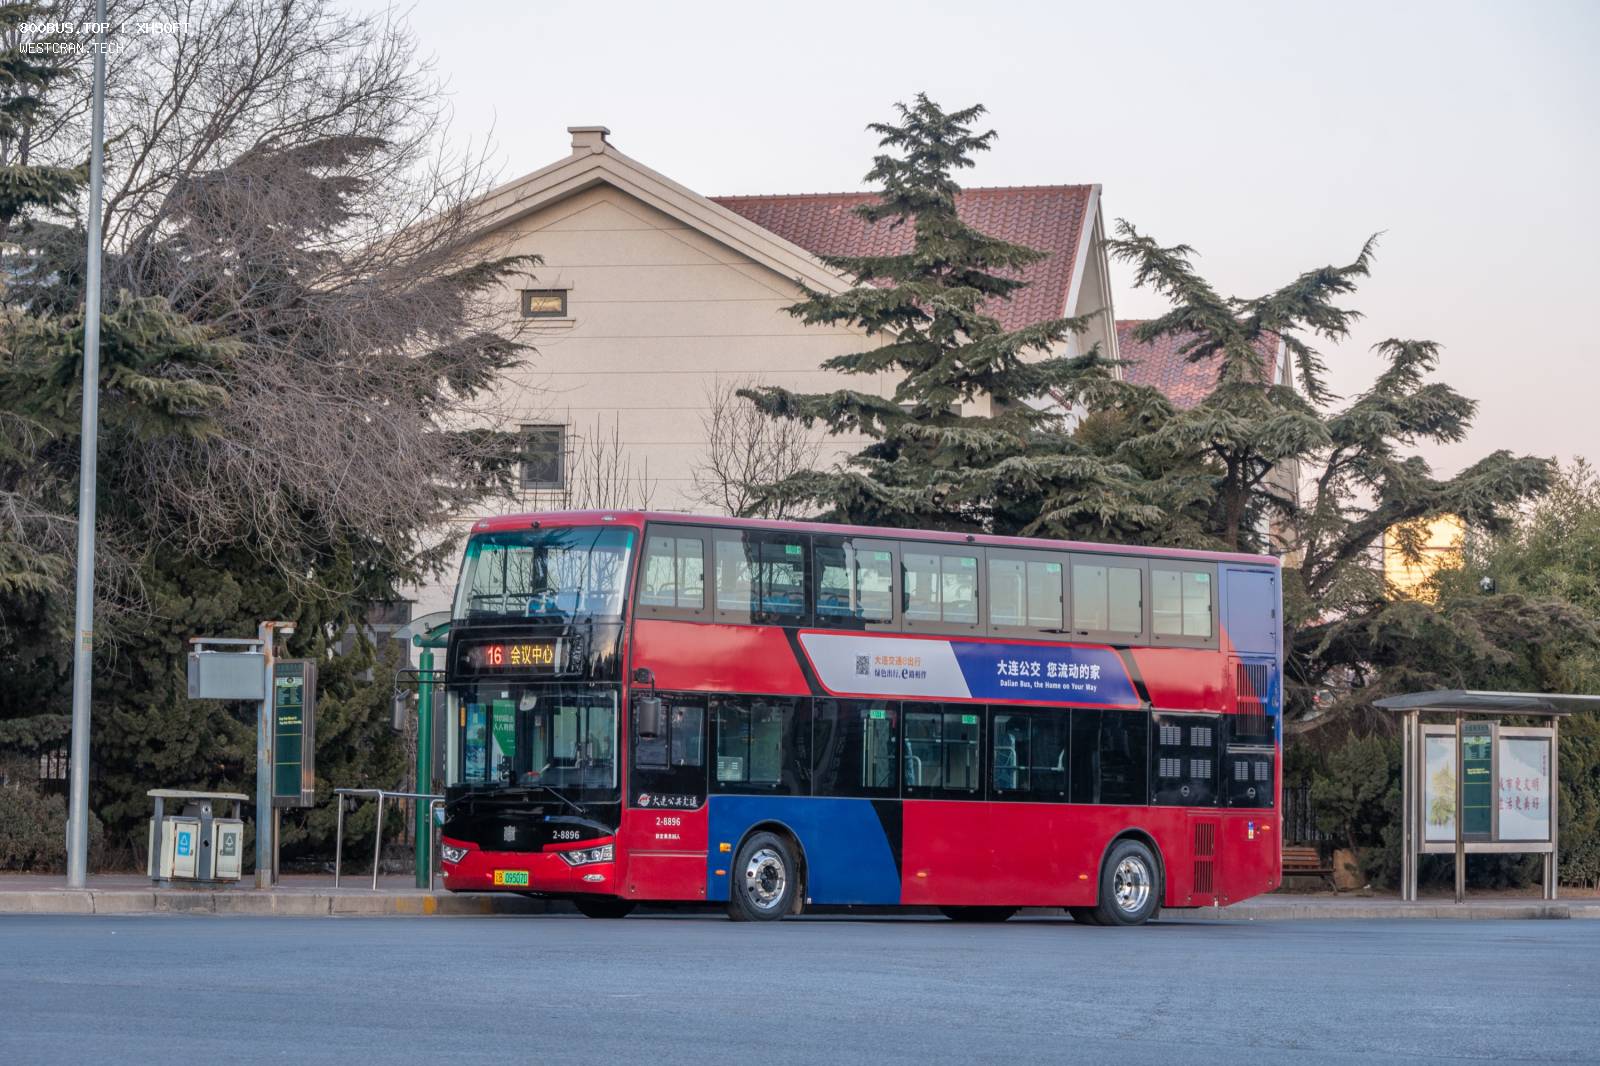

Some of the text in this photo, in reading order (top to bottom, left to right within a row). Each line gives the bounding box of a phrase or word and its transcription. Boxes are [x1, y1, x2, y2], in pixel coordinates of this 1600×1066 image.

[487, 645, 553, 665] 16 会议中心
[997, 659, 1101, 681] 大连公交 您流动的家
[1000, 679, 1018, 687] Dalian
[1045, 681, 1061, 689] Home
[1071, 682, 1084, 690] Your
[1085, 683, 1097, 693] Way
[656, 816, 681, 826] 2-8896
[552, 830, 580, 840] 2-8896
